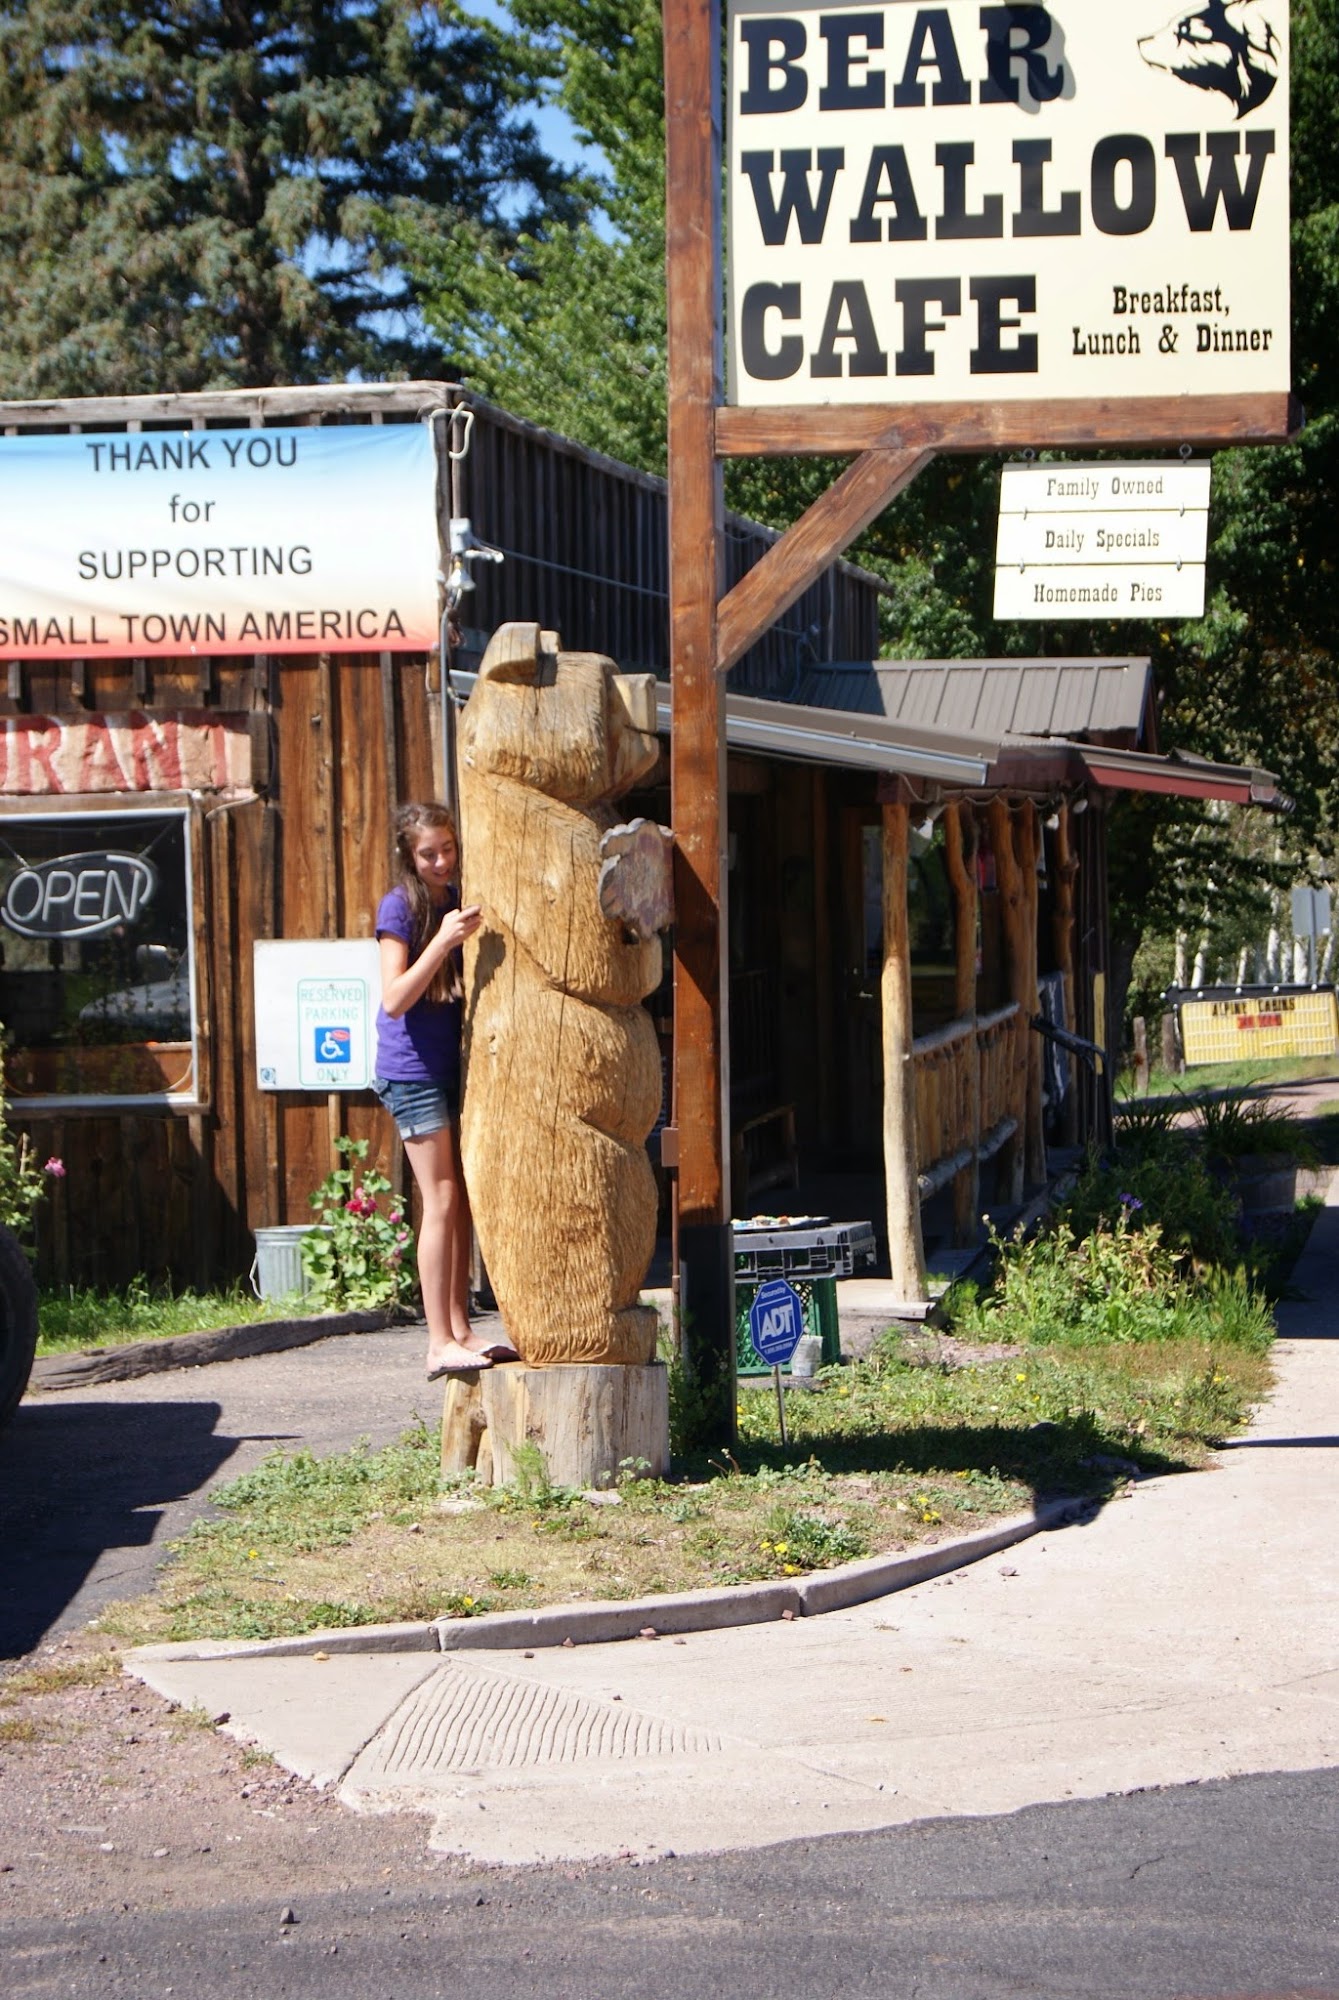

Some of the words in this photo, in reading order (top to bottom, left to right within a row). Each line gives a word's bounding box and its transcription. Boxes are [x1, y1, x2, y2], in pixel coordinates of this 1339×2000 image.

[740, 6, 1064, 115] BEAR
[741, 129, 1275, 246] WALLOW
[1113, 284, 1231, 316] Breakfast,
[741, 274, 1039, 381] CAFE
[1072, 325, 1141, 356] Lunch
[1158, 324, 1180, 354] &
[1196, 322, 1273, 353] Dinner
[86, 440, 210, 471] THANK
[222, 437, 298, 468] YOU
[1047, 477, 1099, 500] Family
[1111, 476, 1163, 495] Owned
[169, 494, 216, 523] for
[1045, 529, 1084, 552] Daily
[1096, 528, 1160, 552] Specials
[78, 546, 313, 580] SUPPORTING
[1034, 583, 1118, 602] Homemade
[1130, 582, 1162, 602] Pies
[120, 612, 225, 643] TOWN
[238, 609, 406, 641] AMERICA
[7, 870, 140, 922] OPEN
[301, 988, 362, 1001] RESERVED
[305, 1006, 359, 1020] PARKING
[316, 1067, 349, 1081] ONLY
[760, 1303, 792, 1340] ADT
